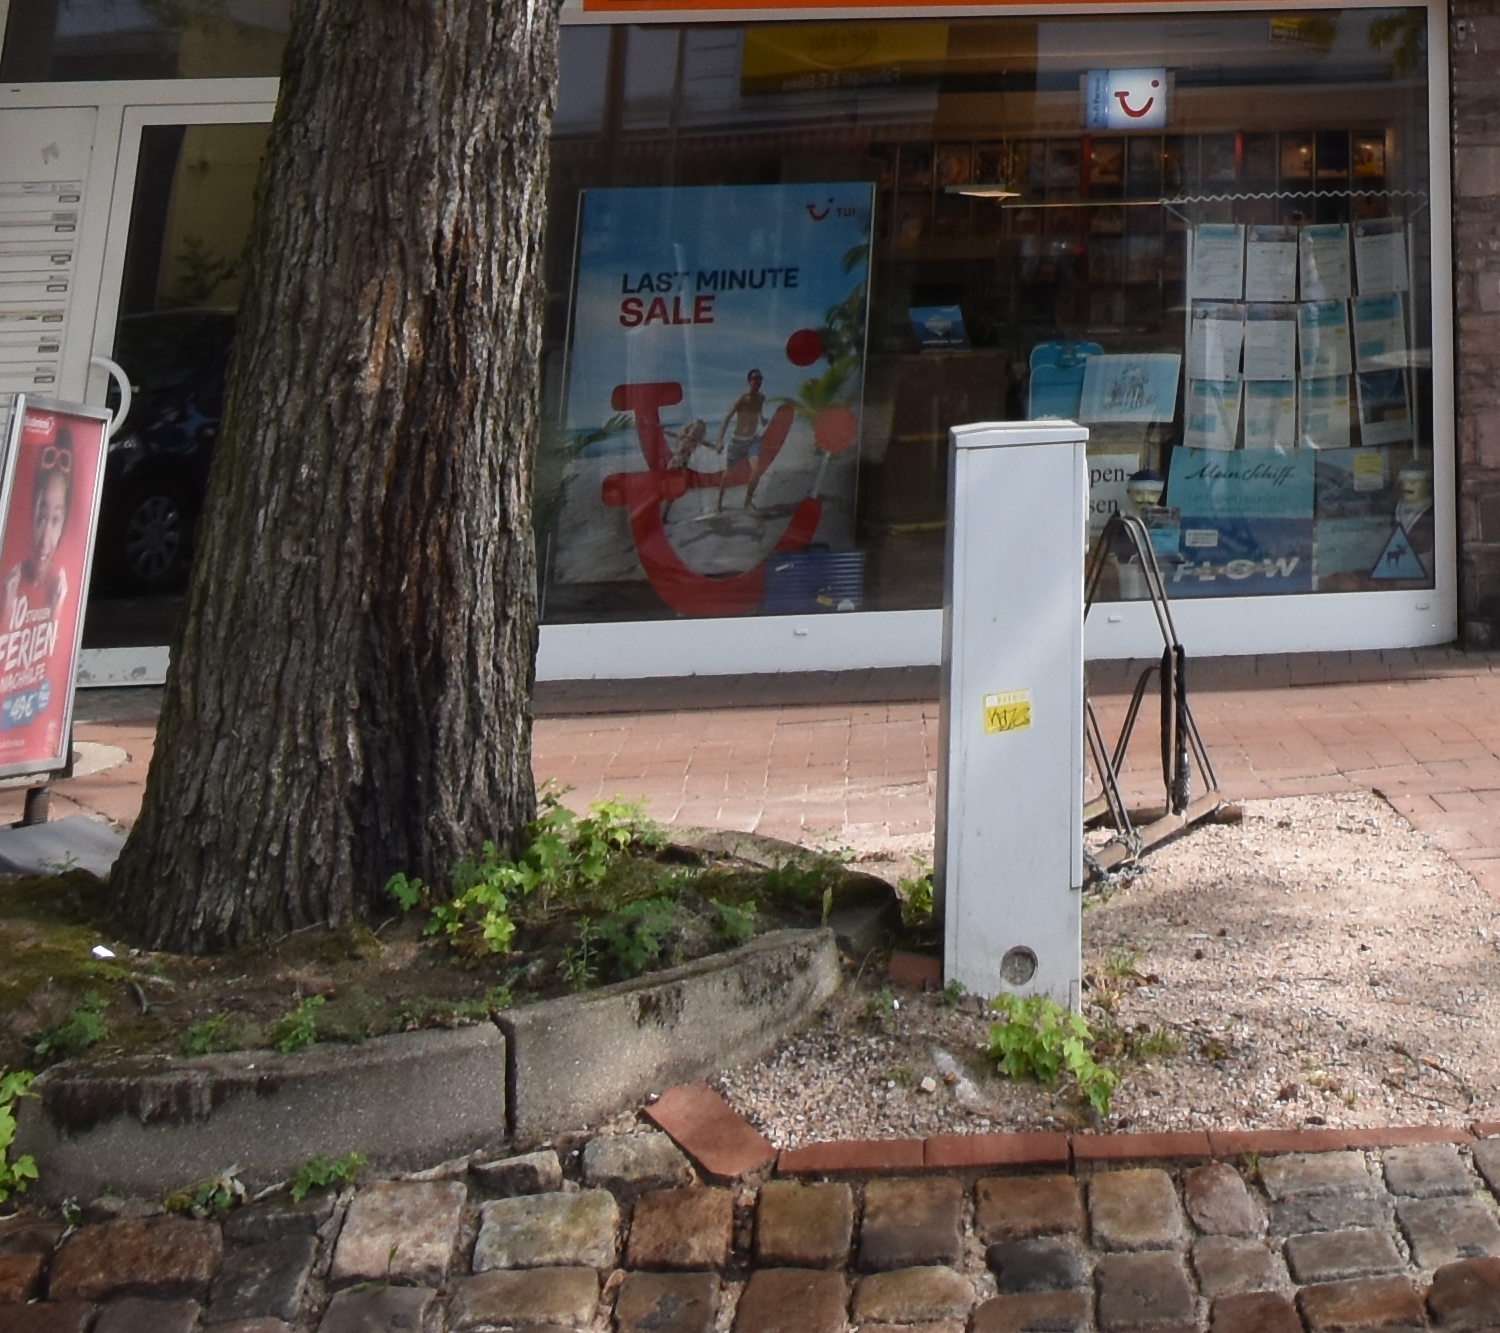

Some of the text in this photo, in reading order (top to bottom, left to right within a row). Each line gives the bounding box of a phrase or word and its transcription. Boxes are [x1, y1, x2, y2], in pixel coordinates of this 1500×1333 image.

[836, 207, 857, 217] TUI
[622, 267, 800, 295] LAST MINUTE
[619, 295, 716, 328] SALE
[1240, 461, 1298, 483] Schiff
[1172, 557, 1300, 583] FLOW
[9, 596, 28, 631] 10
